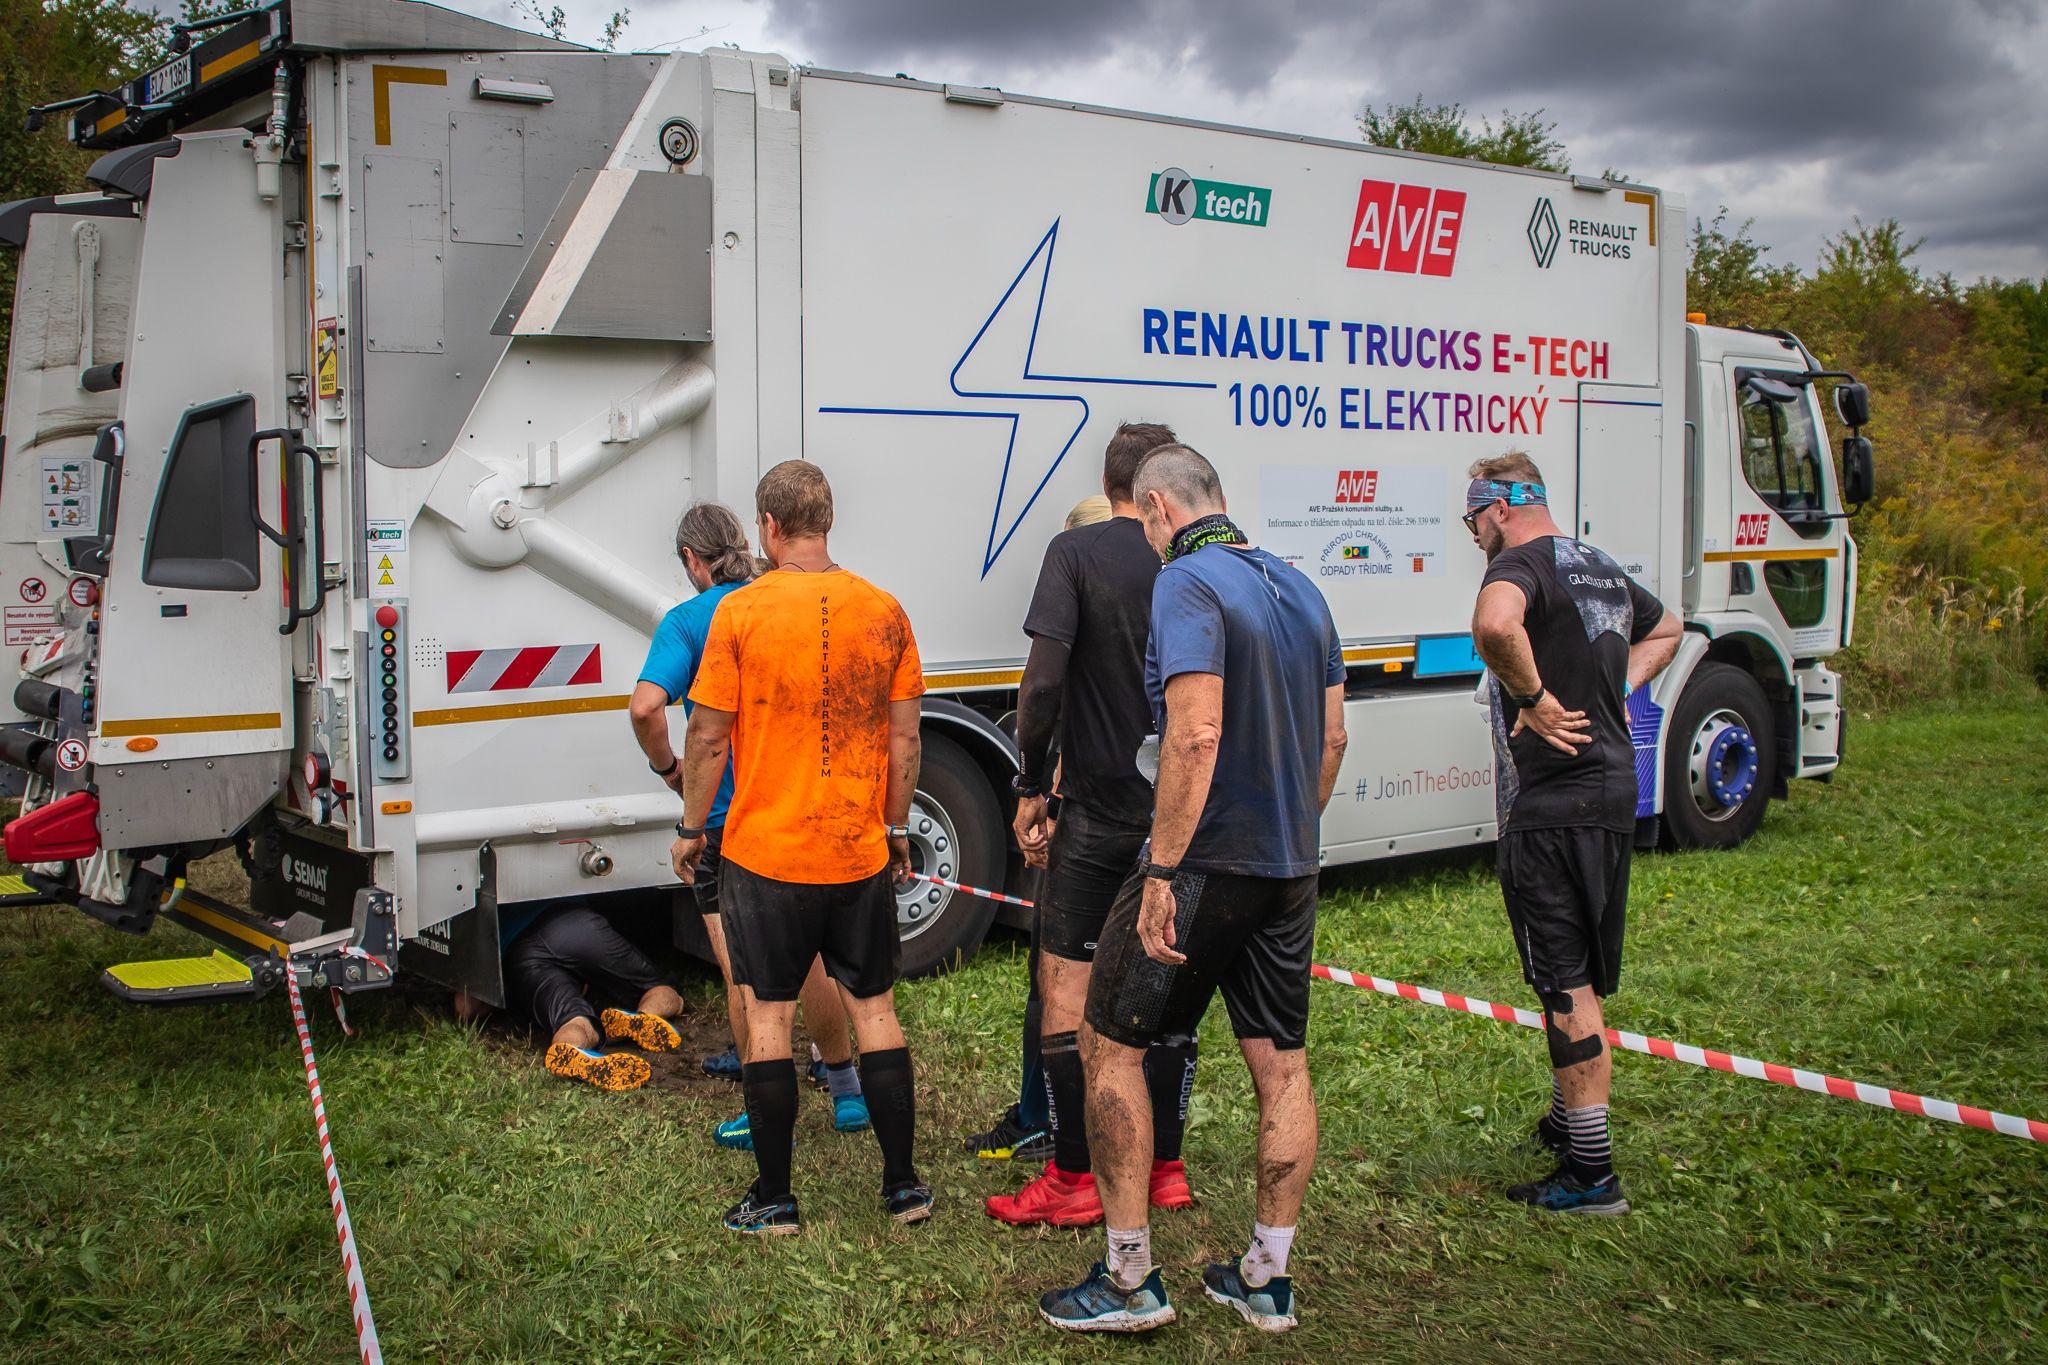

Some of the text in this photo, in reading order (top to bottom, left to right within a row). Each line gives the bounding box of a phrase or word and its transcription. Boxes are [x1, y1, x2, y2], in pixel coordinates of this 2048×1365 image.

[1160, 177, 1262, 222] K tech
[1353, 201, 1459, 256] AVE
[1569, 218, 1638, 242] RENAULT
[1569, 239, 1631, 259] TRUCKS
[1143, 308, 1610, 379] RENAULT TRUCKS E-TECH
[321, 374, 335, 382] ANGLES
[321, 383, 334, 391] MORTS
[1228, 382, 1550, 434] 100% ELEKTRICKÝ
[1336, 478, 1377, 497] AVE
[1322, 505, 1344, 513] Pražské
[1268, 518, 1302, 527] Informace
[1341, 517, 1366, 528] odpadu
[1738, 521, 1769, 538] AVE
[382, 531, 400, 539] tech
[1320, 530, 1393, 562] PŘÍRODU CHRÁNÍME
[1320, 562, 1393, 576] ODPADY TŘÍDÍME
[1568, 573, 1615, 590] GLADIATOR
[1374, 762, 1497, 801] JoinTheGood
[294, 859, 328, 892] SEMAT
[1179, 1057, 1197, 1120] KLIMATEX
